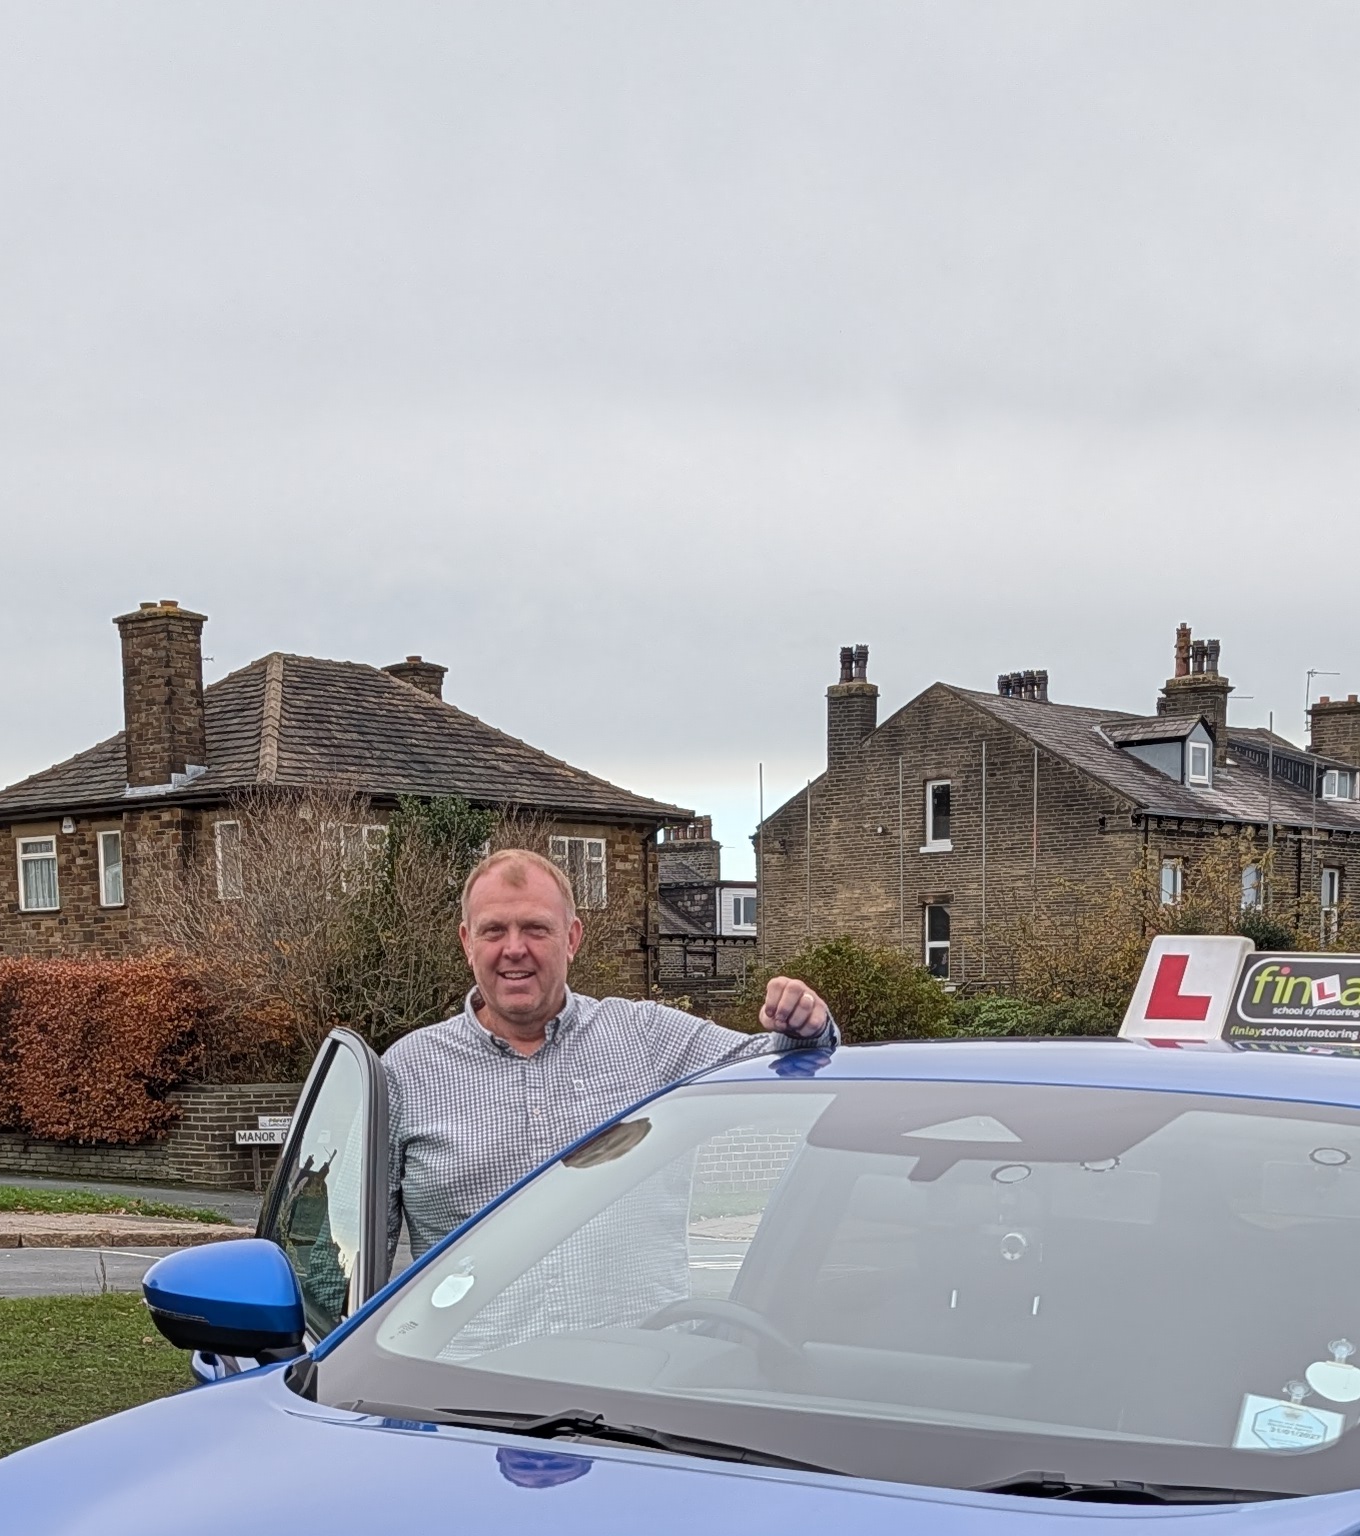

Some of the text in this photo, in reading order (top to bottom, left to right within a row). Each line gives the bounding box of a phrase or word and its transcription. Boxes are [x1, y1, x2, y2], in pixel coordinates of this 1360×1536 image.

[1144, 954, 1212, 1021] L
[1272, 1006, 1360, 1018] school of motoring
[238, 1132, 275, 1142] MANOR
